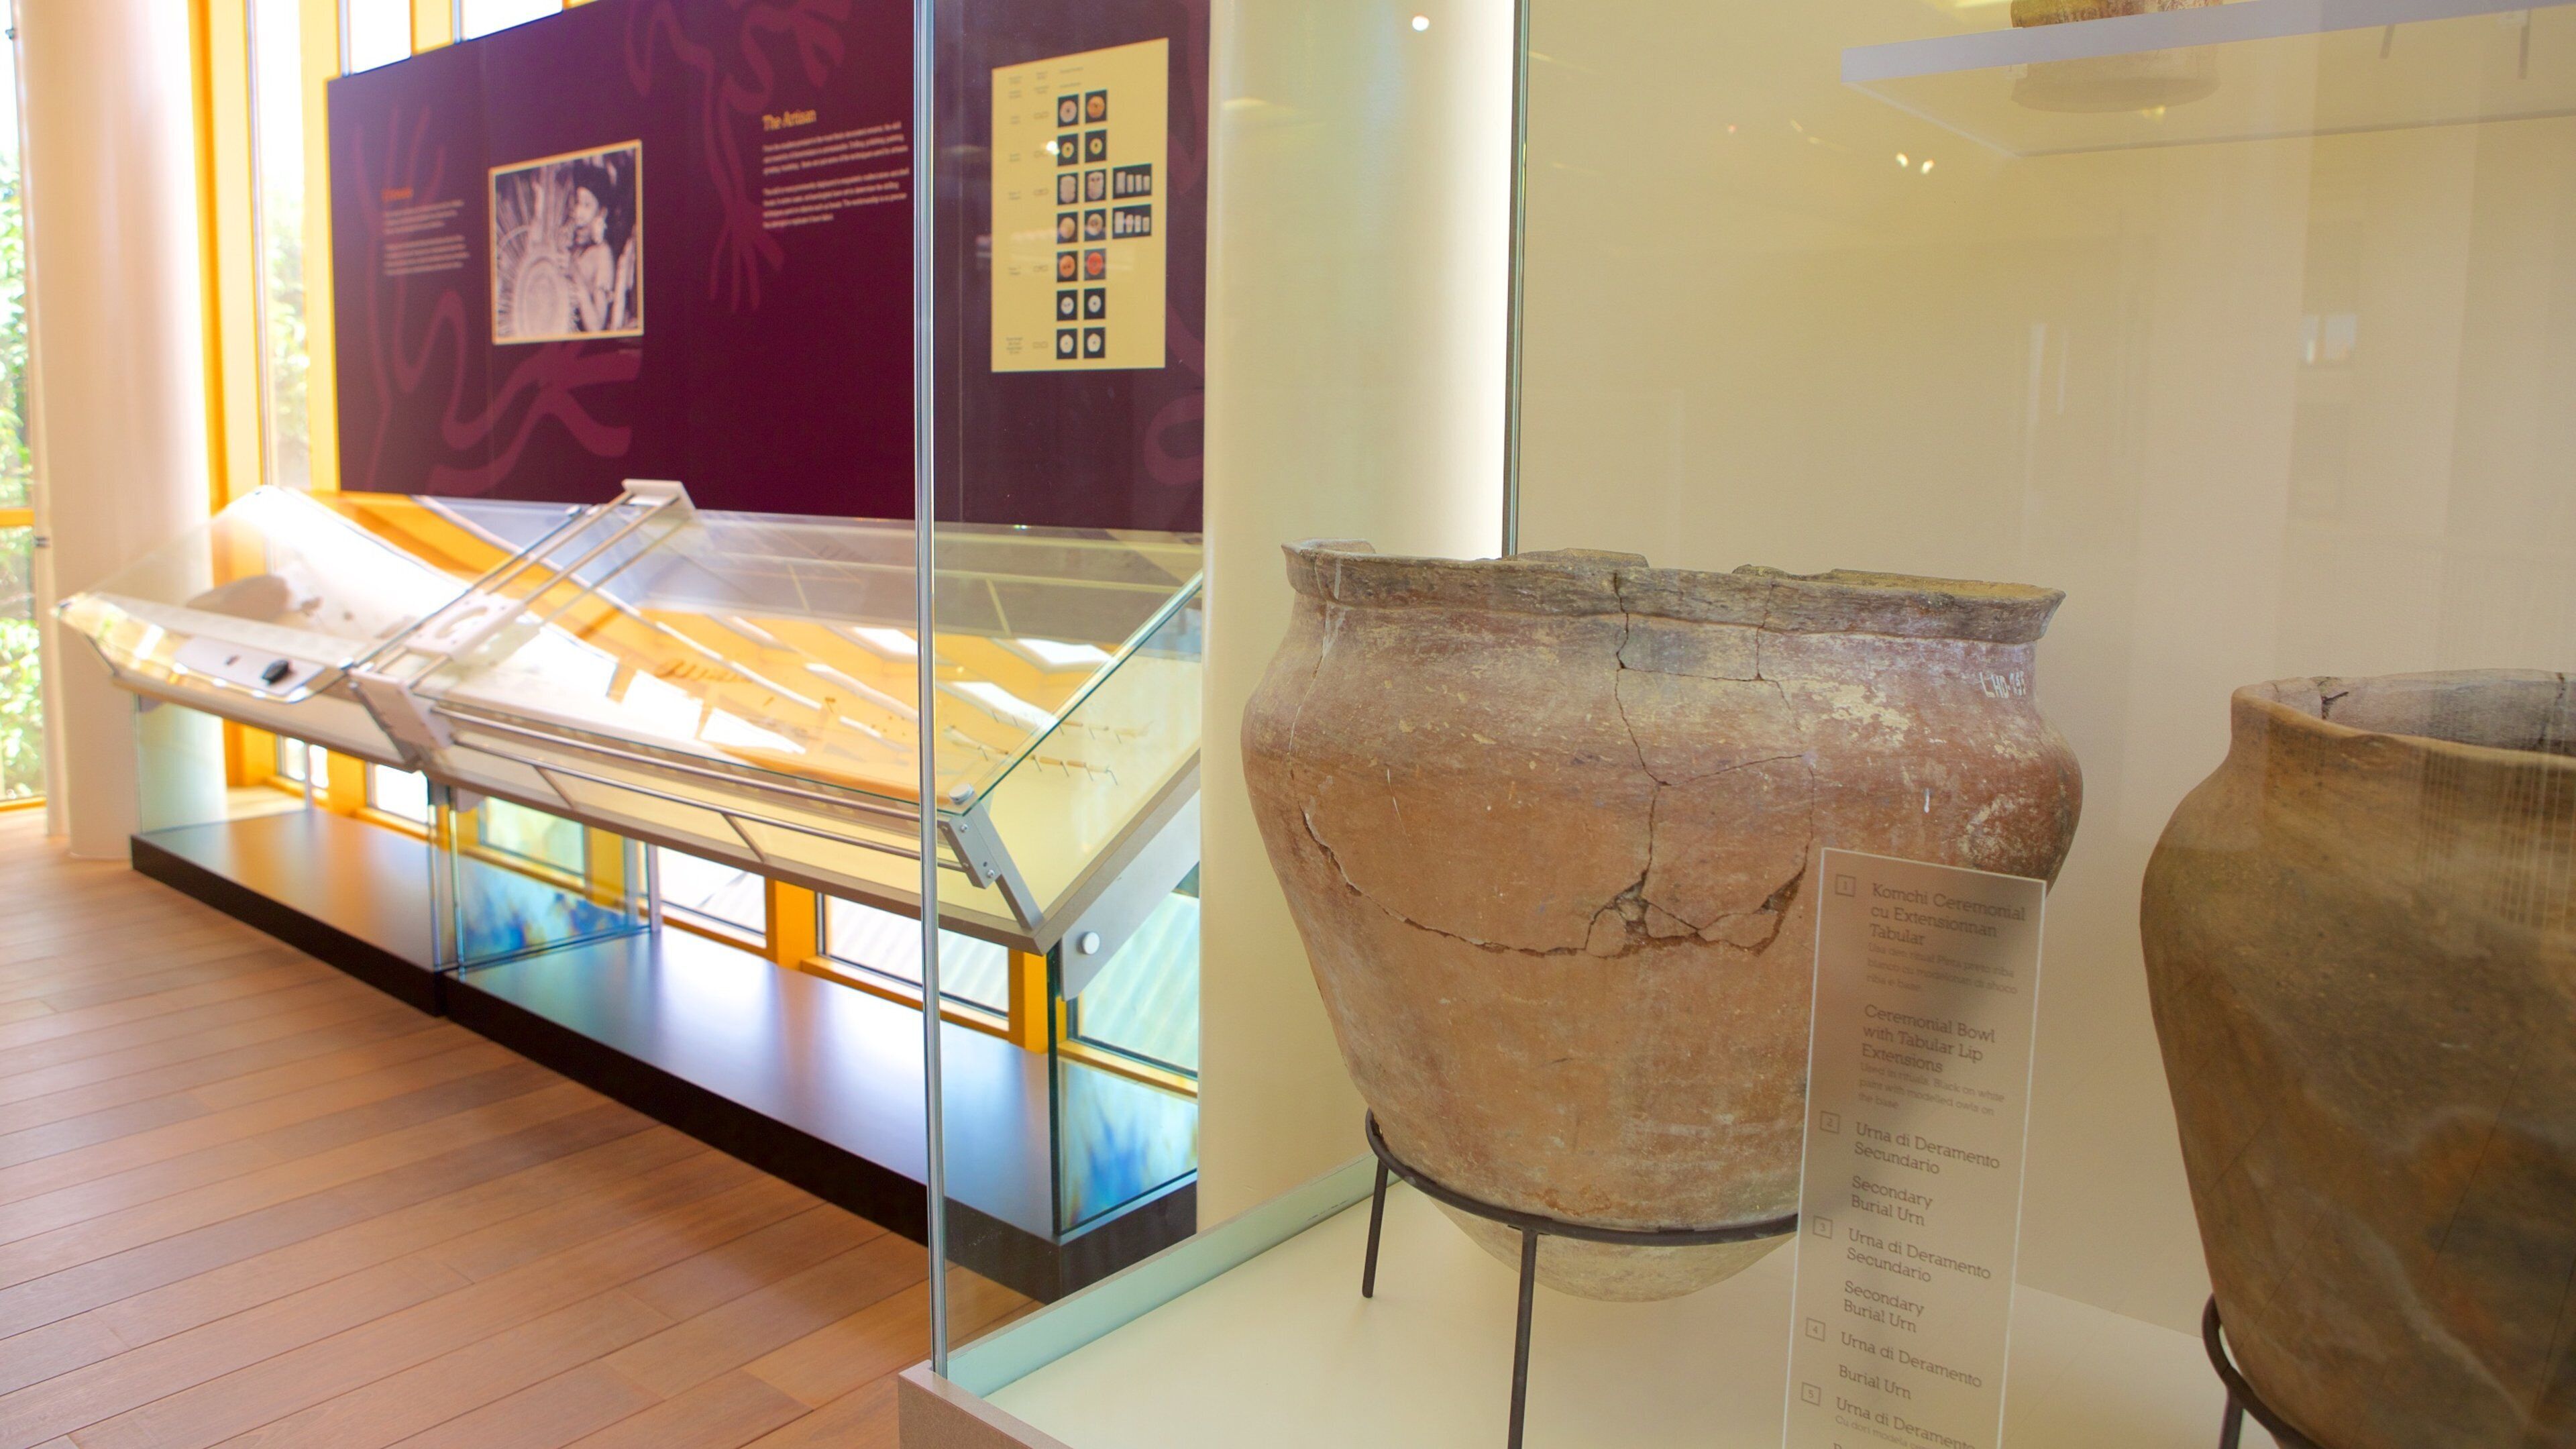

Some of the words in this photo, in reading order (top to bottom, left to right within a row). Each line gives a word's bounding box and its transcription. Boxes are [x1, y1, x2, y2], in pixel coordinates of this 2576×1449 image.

[1872, 883, 1929, 905] Komchi
[1934, 894, 2025, 920] Ceremonial
[1870, 924, 1925, 945] Tabular
[1871, 906, 1889, 918] cu
[1894, 908, 1997, 937] Extensionnan
[1865, 1004, 1952, 1034] Ceremonial
[1958, 1021, 1995, 1042] Bowl
[1862, 1044, 1943, 1073] Extensions
[1864, 1025, 1893, 1042] with
[1898, 1031, 1953, 1055] Tabular
[1958, 1043, 1982, 1063] Lip
[1854, 1142, 1940, 1174] Secundario
[1856, 1122, 1892, 1142] Urna
[1896, 1133, 1911, 1147] di
[1915, 1136, 2000, 1169] Deramento
[1852, 1176, 1933, 1210] Secondary
[1851, 1195, 1892, 1218] Burial
[1897, 1206, 1925, 1226] Urn
[1847, 1248, 1931, 1282] Secundario
[1849, 1228, 1883, 1250] Urna
[1888, 1239, 1902, 1254] di
[1907, 1244, 1990, 1279] Deramento
[1845, 1281, 1924, 1316] Secondary
[1844, 1299, 1885, 1323] Burial
[1889, 1312, 1917, 1333] Urn
[1841, 1332, 1876, 1354] Urna
[1880, 1344, 1894, 1359] di
[1898, 1350, 1982, 1388] Deramento
[1839, 1364, 1880, 1389] Burial
[1884, 1379, 1912, 1399] Urn
[1836, 1397, 1870, 1419] Urna
[1875, 1413, 1889, 1426] di
